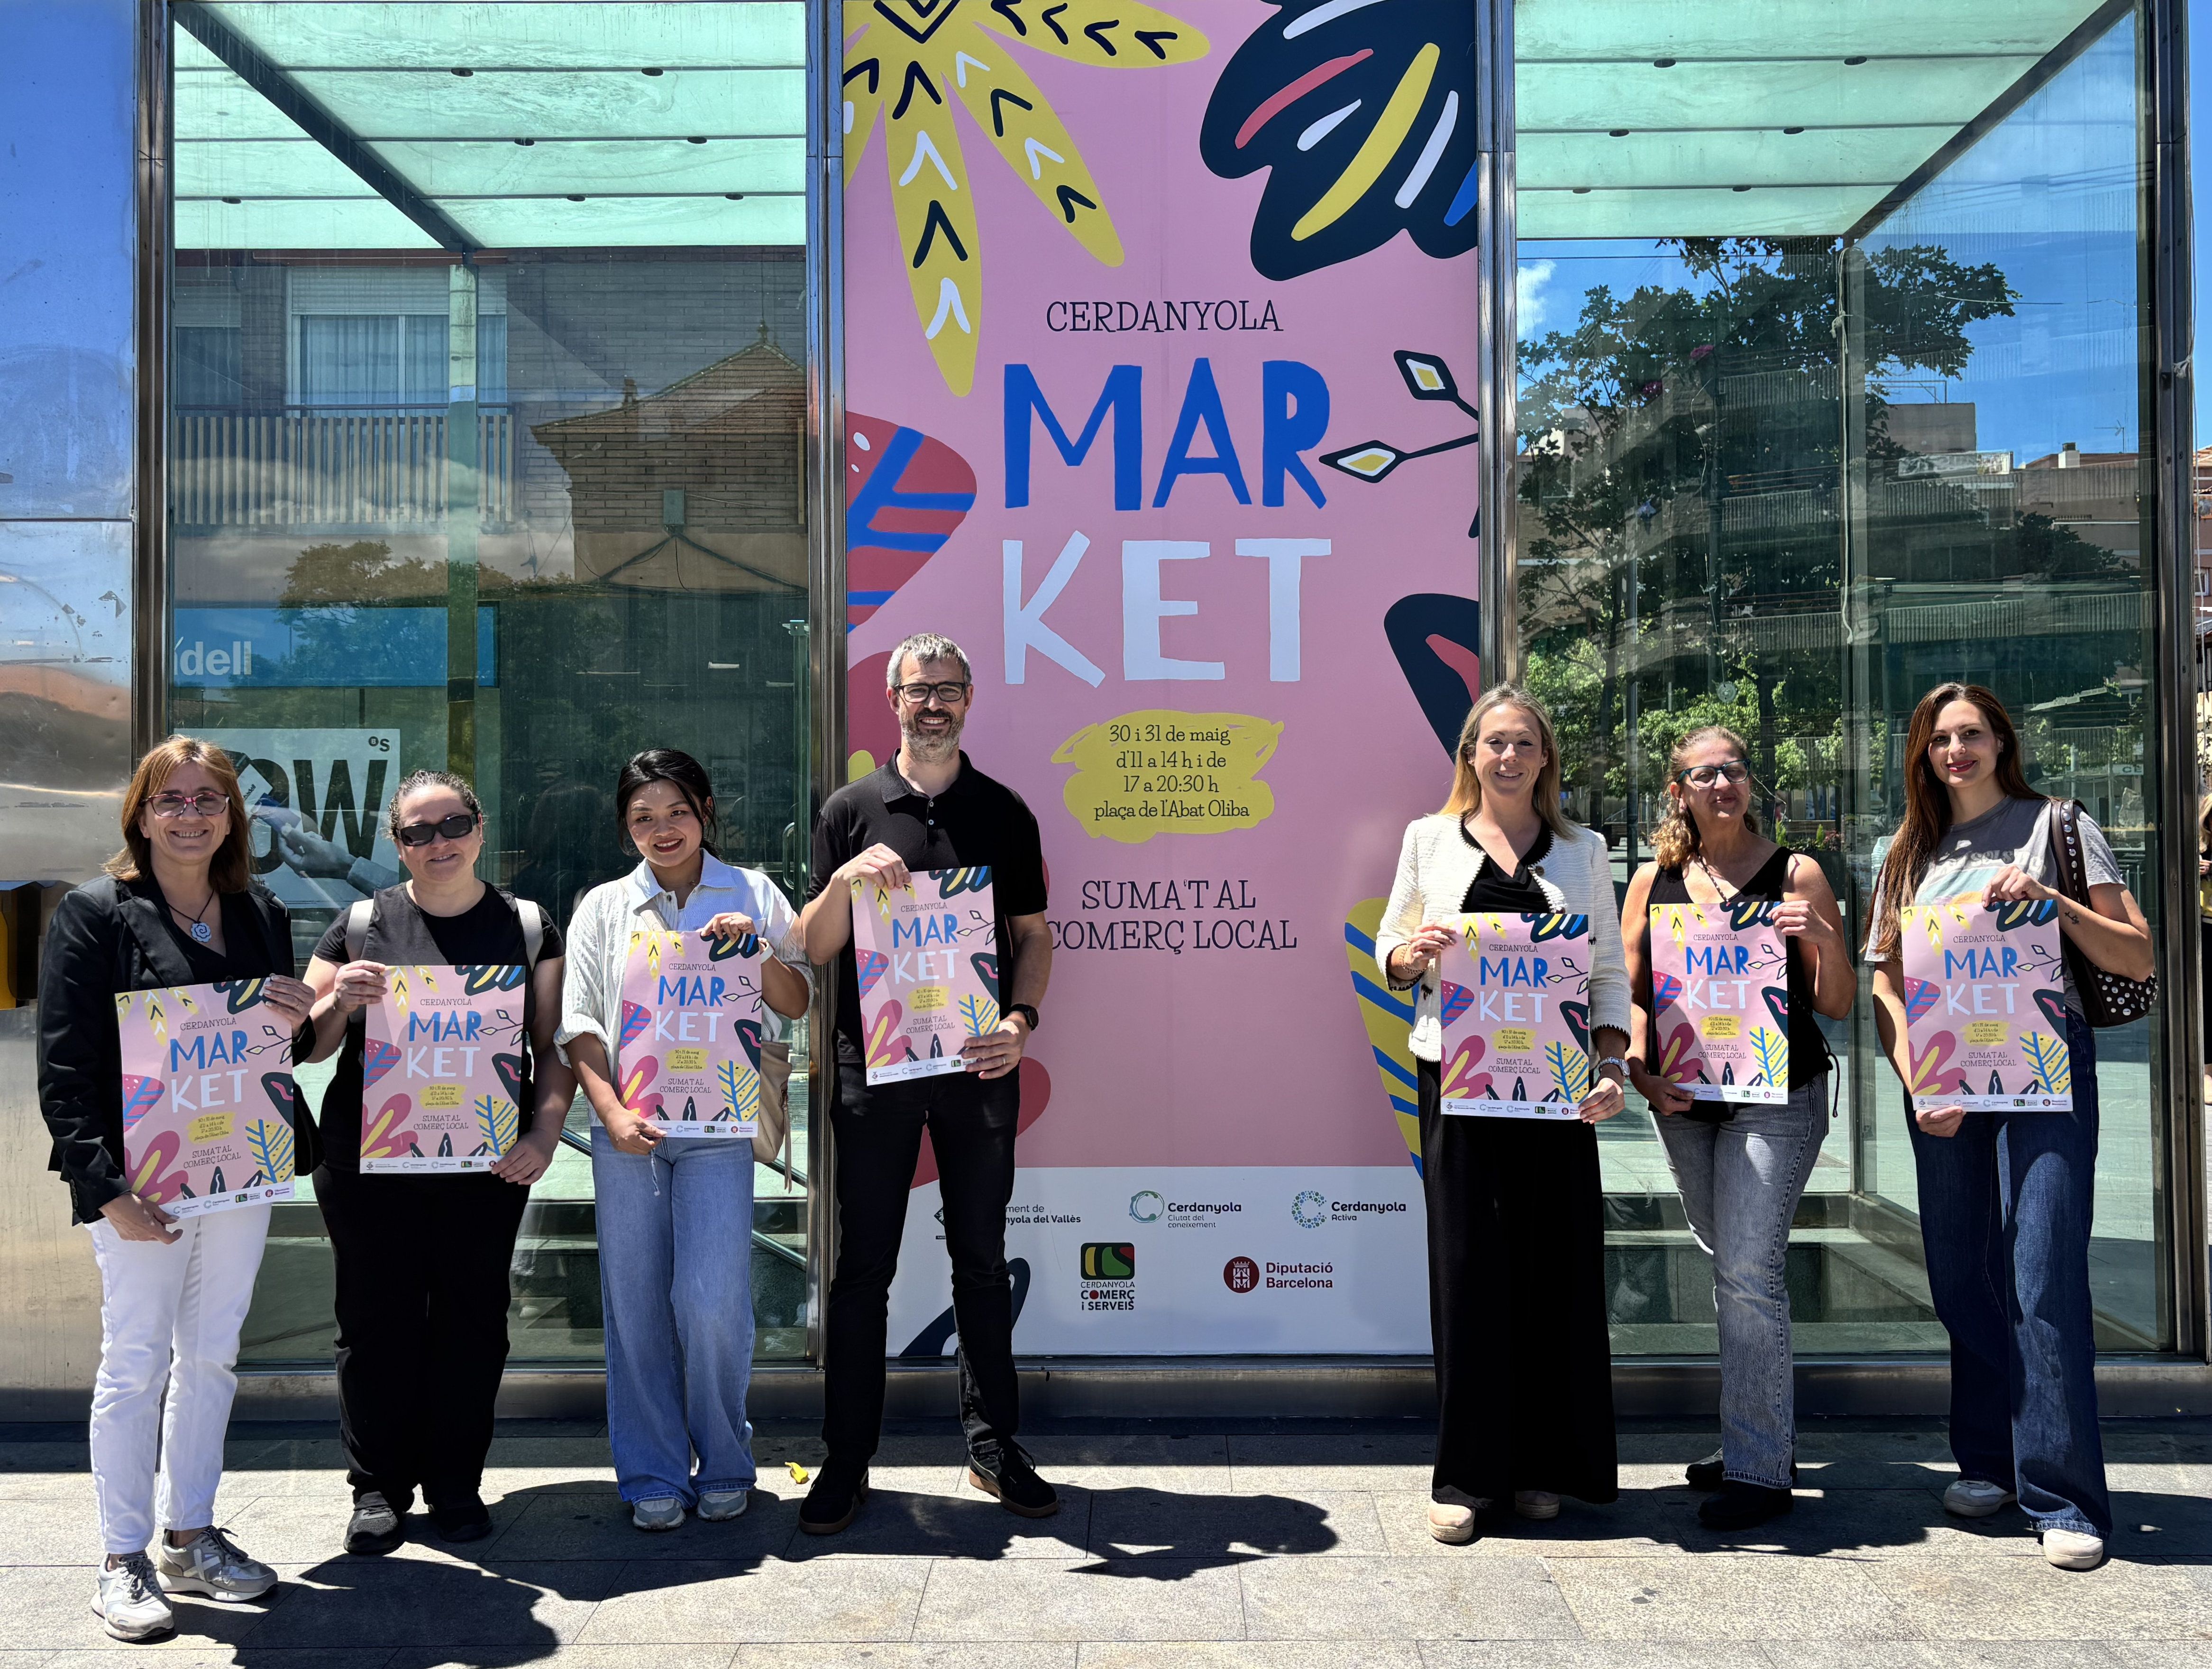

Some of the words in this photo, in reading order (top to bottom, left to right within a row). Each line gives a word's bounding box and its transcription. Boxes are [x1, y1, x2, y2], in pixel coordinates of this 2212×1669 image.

[1047, 300, 1284, 332] CERDANYOLA
[1004, 358, 1330, 511] MAR
[1003, 530, 1331, 688] KET
[1109, 724, 1131, 742] 30
[1135, 729, 1141, 742] i
[1145, 724, 1161, 742] 31
[1166, 725, 1185, 742] de
[1190, 728, 1230, 745] maig
[1116, 750, 1143, 768] d'11
[1148, 758, 1157, 768] a
[1161, 751, 1178, 768] 14
[1183, 751, 1193, 768] h
[1197, 754, 1202, 768] i
[1207, 751, 1226, 768] de
[1124, 775, 1140, 792] 17
[1144, 782, 1153, 792] a
[1157, 775, 1204, 792] 20:30
[1208, 775, 1219, 792] h
[1094, 800, 1136, 820] plaça
[1139, 801, 1158, 817] de
[1161, 800, 1205, 817] l'Abat
[1208, 800, 1250, 817] Oliba
[901, 902, 947, 912] CERDANYOLA
[1213, 880, 1256, 910] AL
[893, 914, 958, 948] MAR
[1193, 920, 1297, 950] LOCAL
[1953, 935, 2006, 943] CERDANYOLA
[1489, 944, 1538, 953] CERDANYOLA
[1686, 945, 1749, 975] MAR
[669, 963, 716, 972] CERDANYOLA
[894, 949, 960, 984] KET
[1480, 956, 1548, 988] MAR
[1944, 947, 2018, 979] MAR
[420, 998, 472, 1006] CERDANYOLA
[658, 975, 725, 1007] MAR
[1686, 979, 1751, 1009] KET
[1946, 983, 2020, 1016] KET
[1480, 990, 1548, 1023] KET
[180, 1017, 237, 1031] CERDANYOLA
[409, 1010, 482, 1042] MAR
[655, 1009, 723, 1042] KET
[935, 1022, 955, 1030] LOCAL
[170, 1030, 248, 1073] MAR
[407, 1045, 481, 1078] KET
[171, 1069, 249, 1113] KET
[217, 1152, 241, 1163] LOCAL
[1033, 1204, 1044, 1212] de
[1033, 1215, 1049, 1223] del
[1051, 1215, 1081, 1223] Vallès
[1168, 1202, 1242, 1214] Cerdanyola
[1331, 1201, 1407, 1214] Cerdanyola
[1266, 1262, 1333, 1275] Diputació
[1266, 1277, 1333, 1288] Barcelona
[1081, 1302, 1084, 1311] i
[1088, 1301, 1134, 1311] SERVEIS
